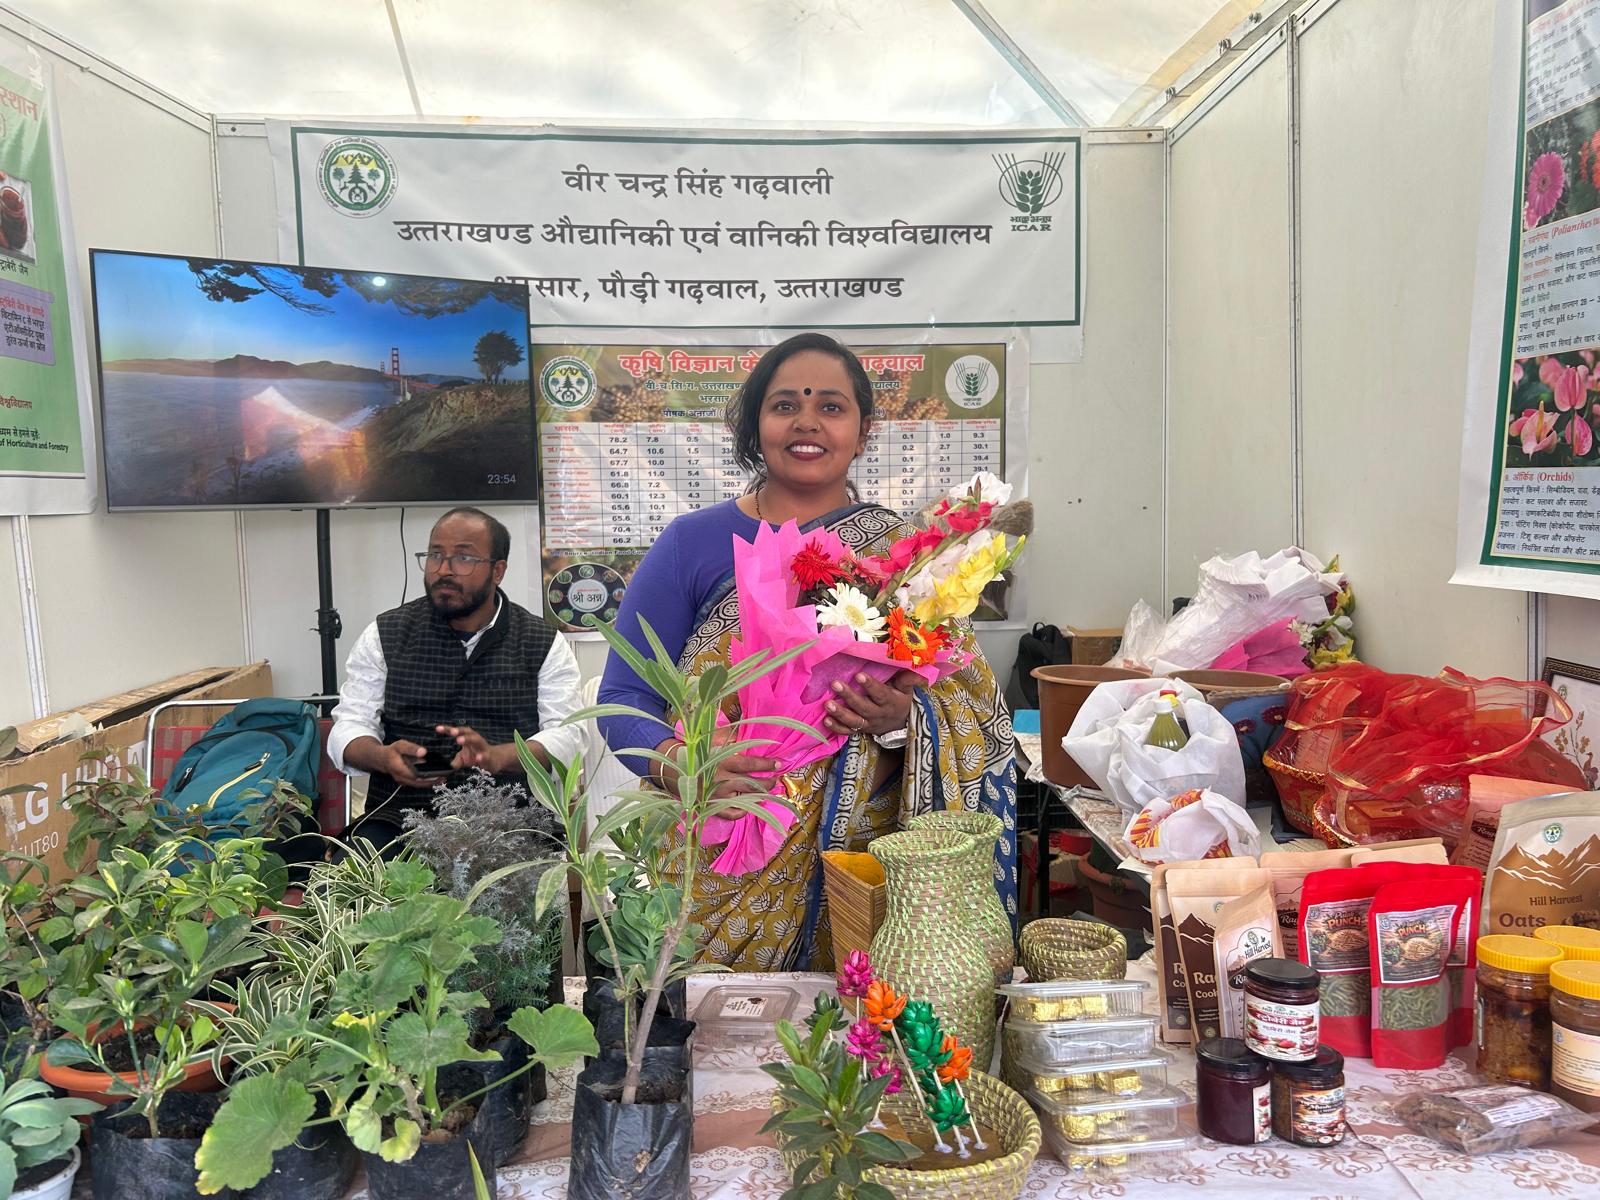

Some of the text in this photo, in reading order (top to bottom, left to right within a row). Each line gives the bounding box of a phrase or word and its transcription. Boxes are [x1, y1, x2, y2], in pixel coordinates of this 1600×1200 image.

[562, 164, 833, 200] वीर चन्द्र सिंह गढ़वाली
[394, 215, 992, 253] उत्तराखण्ड औद्यानिकी एवं वानिकी विश्वविद्यालय
[1010, 223, 1052, 232] ICAR
[598, 269, 659, 304] पौड़ी
[665, 279, 765, 305] गढ़वाल,
[775, 277, 904, 298] उत्तराखण्ड
[618, 350, 664, 377] कृषि
[668, 350, 735, 374] विज्ञान
[7, 439, 37, 448] Horticulture
[39, 441, 47, 449] and
[49, 442, 69, 453] Forestry
[487, 474, 516, 484] 23:54
[1537, 472, 1574, 483] (Orchids)
[1529, 894, 1583, 906] Hill Harvest
[1327, 916, 1361, 929] PUNCH
[1499, 912, 1546, 928] Oats
[1398, 924, 1426, 937] PUNCH
[1193, 971, 1215, 985] Ra
